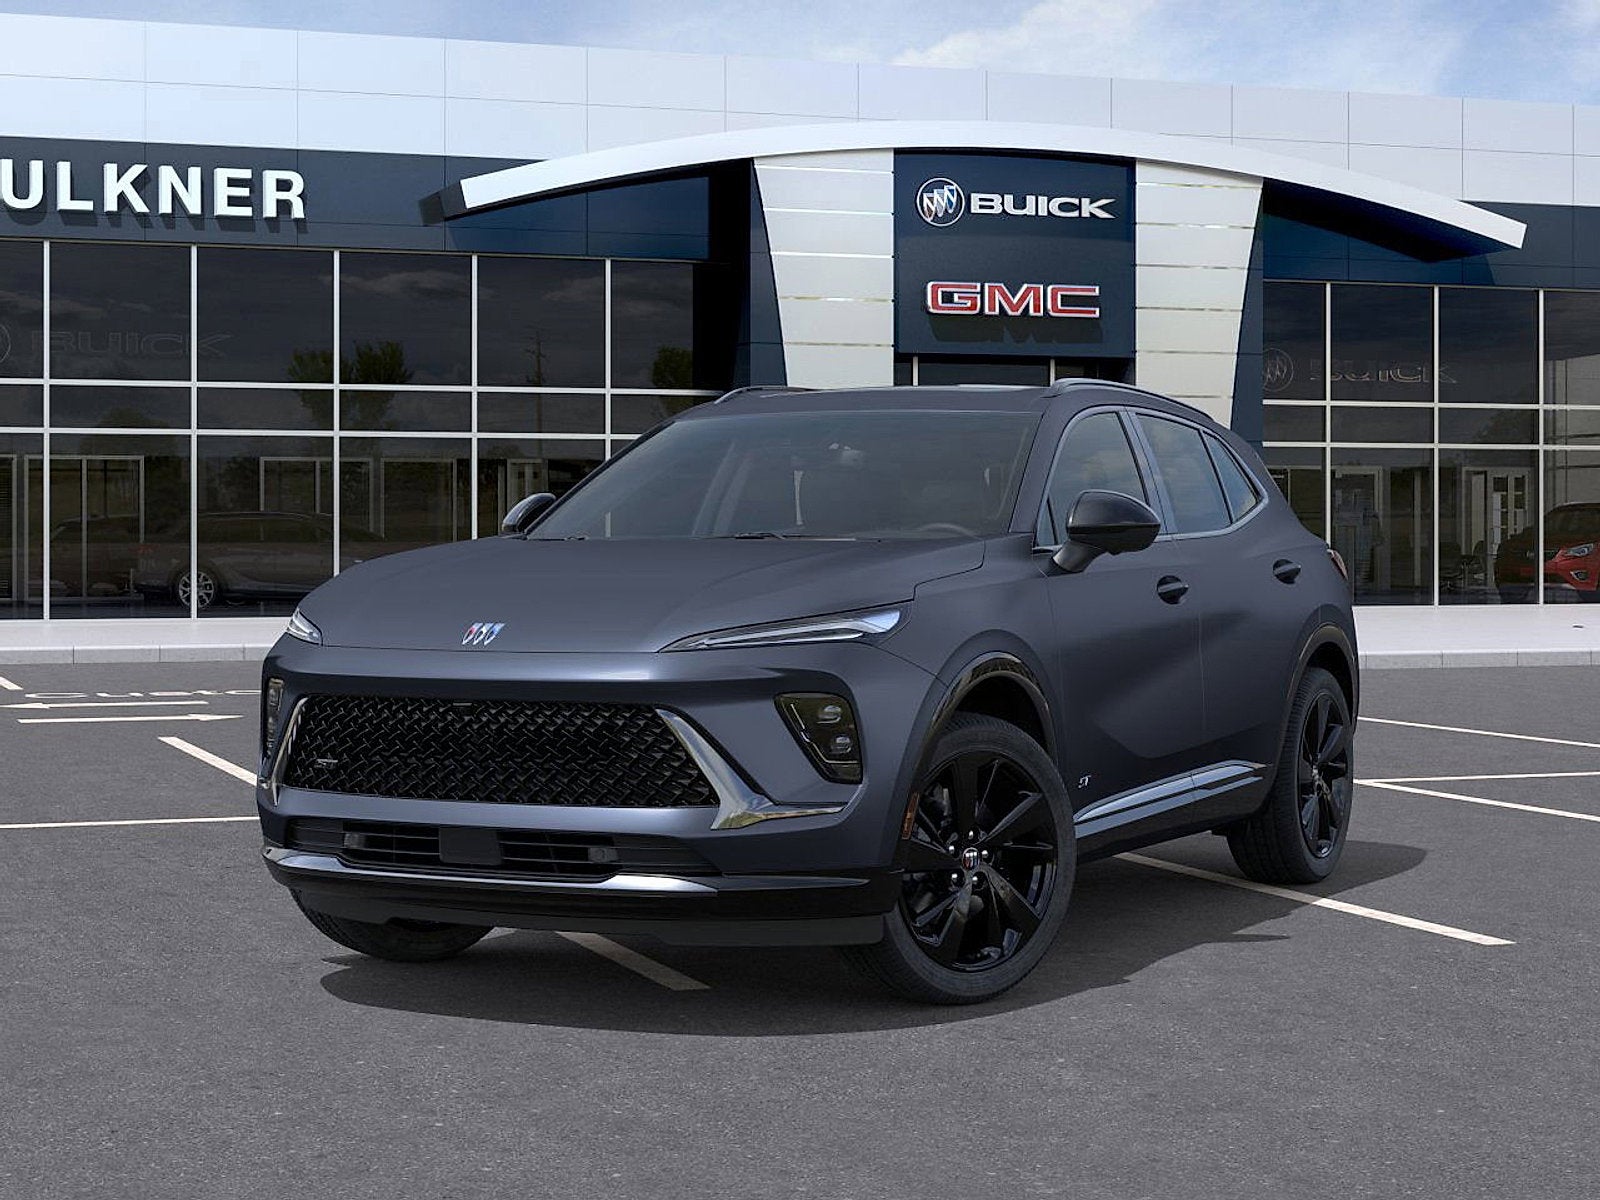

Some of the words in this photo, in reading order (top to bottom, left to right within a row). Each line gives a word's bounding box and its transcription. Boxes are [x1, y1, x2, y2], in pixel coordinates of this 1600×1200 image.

[0, 158, 306, 219] ULKNER
[970, 193, 1115, 219] BUICK
[927, 281, 1101, 318] GMC
